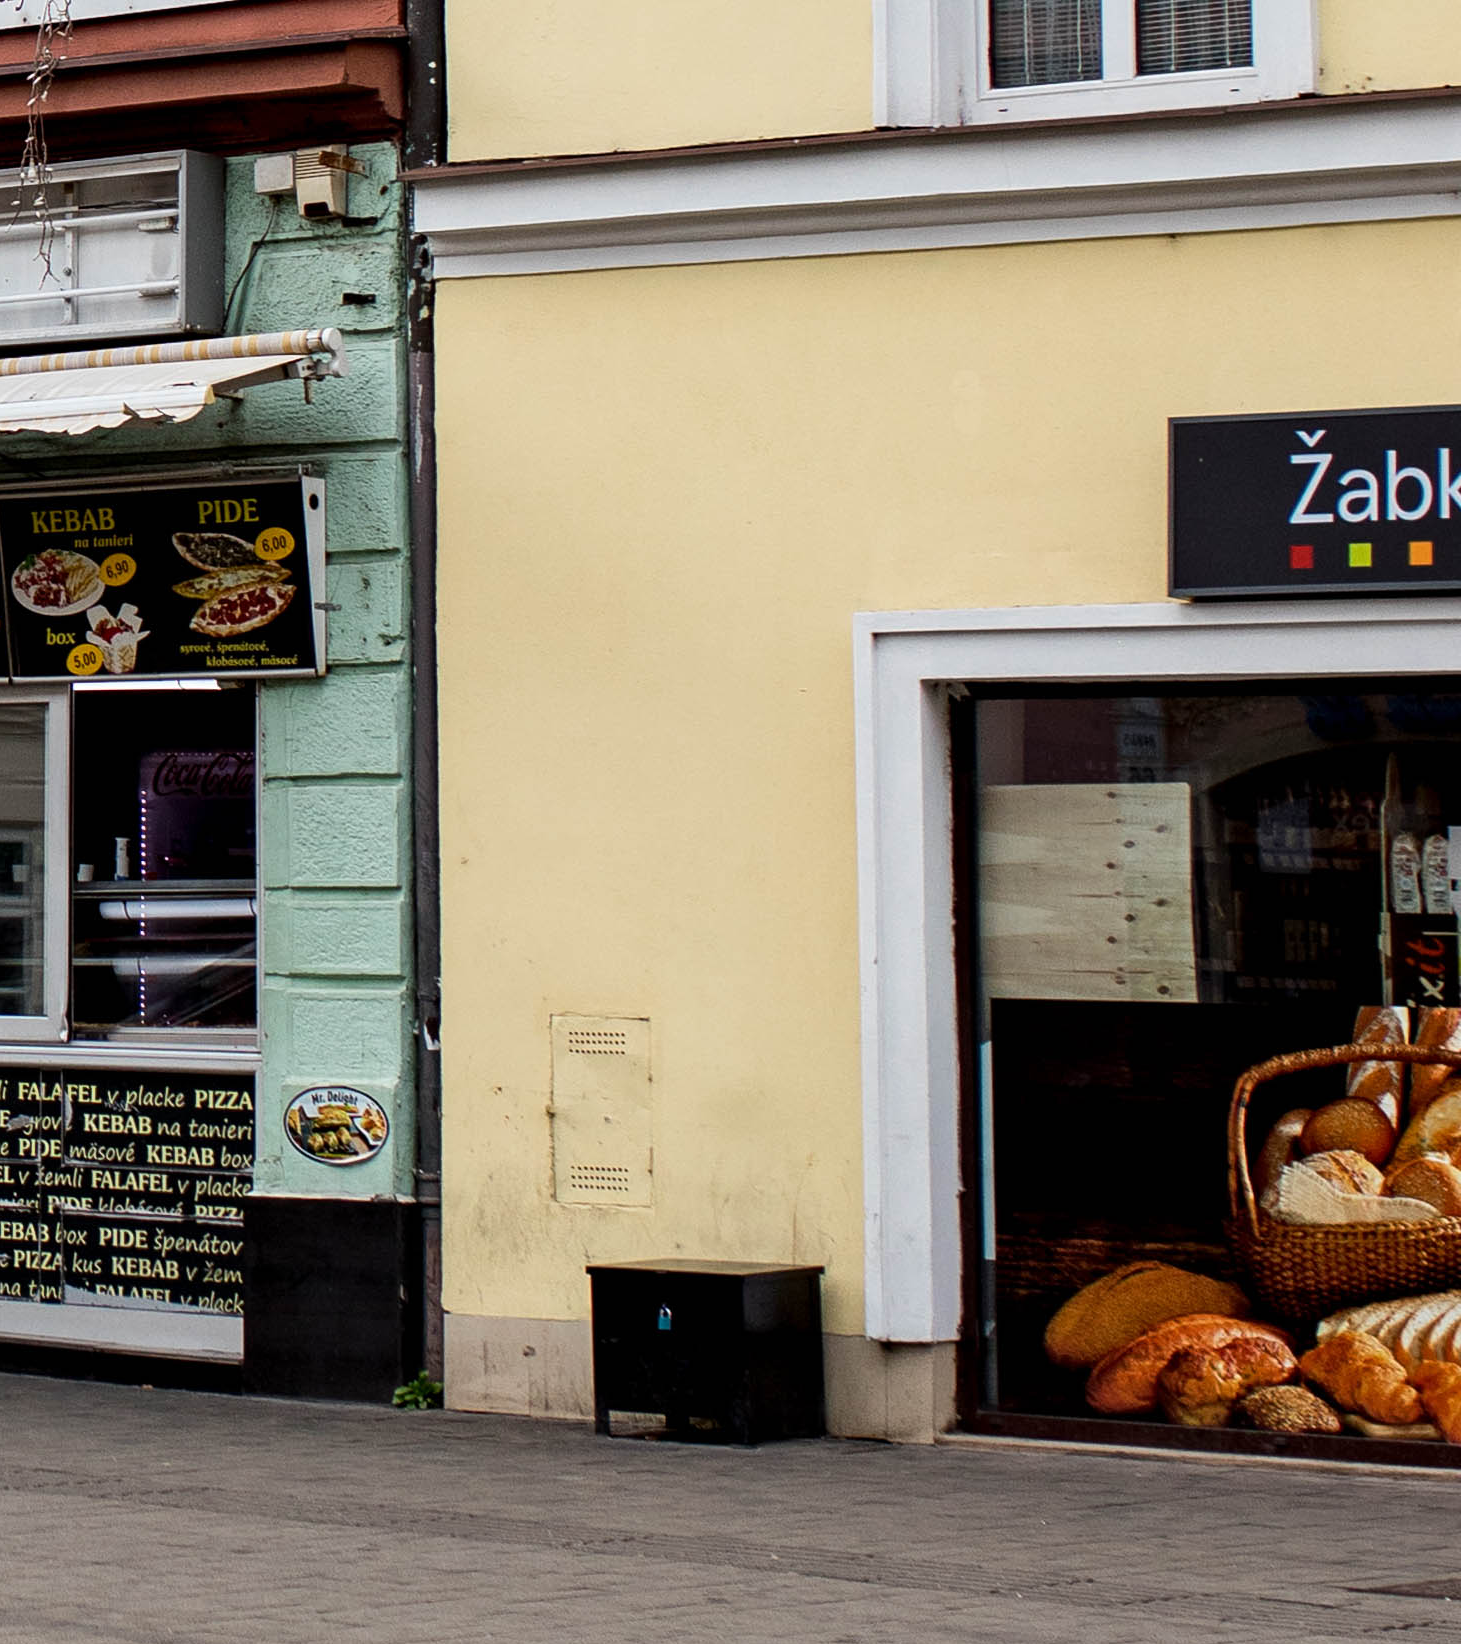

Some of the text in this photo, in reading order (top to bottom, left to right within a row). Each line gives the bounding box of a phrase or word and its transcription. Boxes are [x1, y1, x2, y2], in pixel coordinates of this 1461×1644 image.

[1288, 429, 1461, 524] Žabk
[31, 508, 116, 534] KEBAB
[198, 498, 260, 525] PIDE
[74, 534, 134, 548] na tanieri
[262, 534, 287, 553] 6,00
[46, 627, 76, 646] box
[73, 650, 97, 670] 5,00
[18, 1081, 103, 1104] FALAFEL
[107, 1089, 119, 1104] v
[126, 1085, 186, 1113] placke
[194, 1088, 254, 1111] PIZZA
[327, 1090, 359, 1106] Delight
[83, 1113, 152, 1135] KEBAB
[157, 1121, 181, 1137] na
[188, 1117, 253, 1140] tanieri
[18, 1137, 62, 1158] PIDE
[69, 1141, 136, 1163] mäsové
[146, 1144, 216, 1167] KEBAB
[220, 1145, 254, 1169] box
[18, 1170, 30, 1185] v
[34, 1165, 85, 1187] žemli
[91, 1169, 174, 1193] FALAFEL
[177, 1179, 190, 1195] v
[194, 1174, 252, 1202] placke
[99, 1227, 149, 1249] PIDE
[153, 1227, 244, 1258] špenátov
[13, 1249, 67, 1272] PIZZA
[72, 1252, 103, 1275] kus
[111, 1256, 180, 1280] KEBAB
[185, 1266, 198, 1282] v
[202, 1260, 244, 1285] žem
[0, 1281, 22, 1297] na
